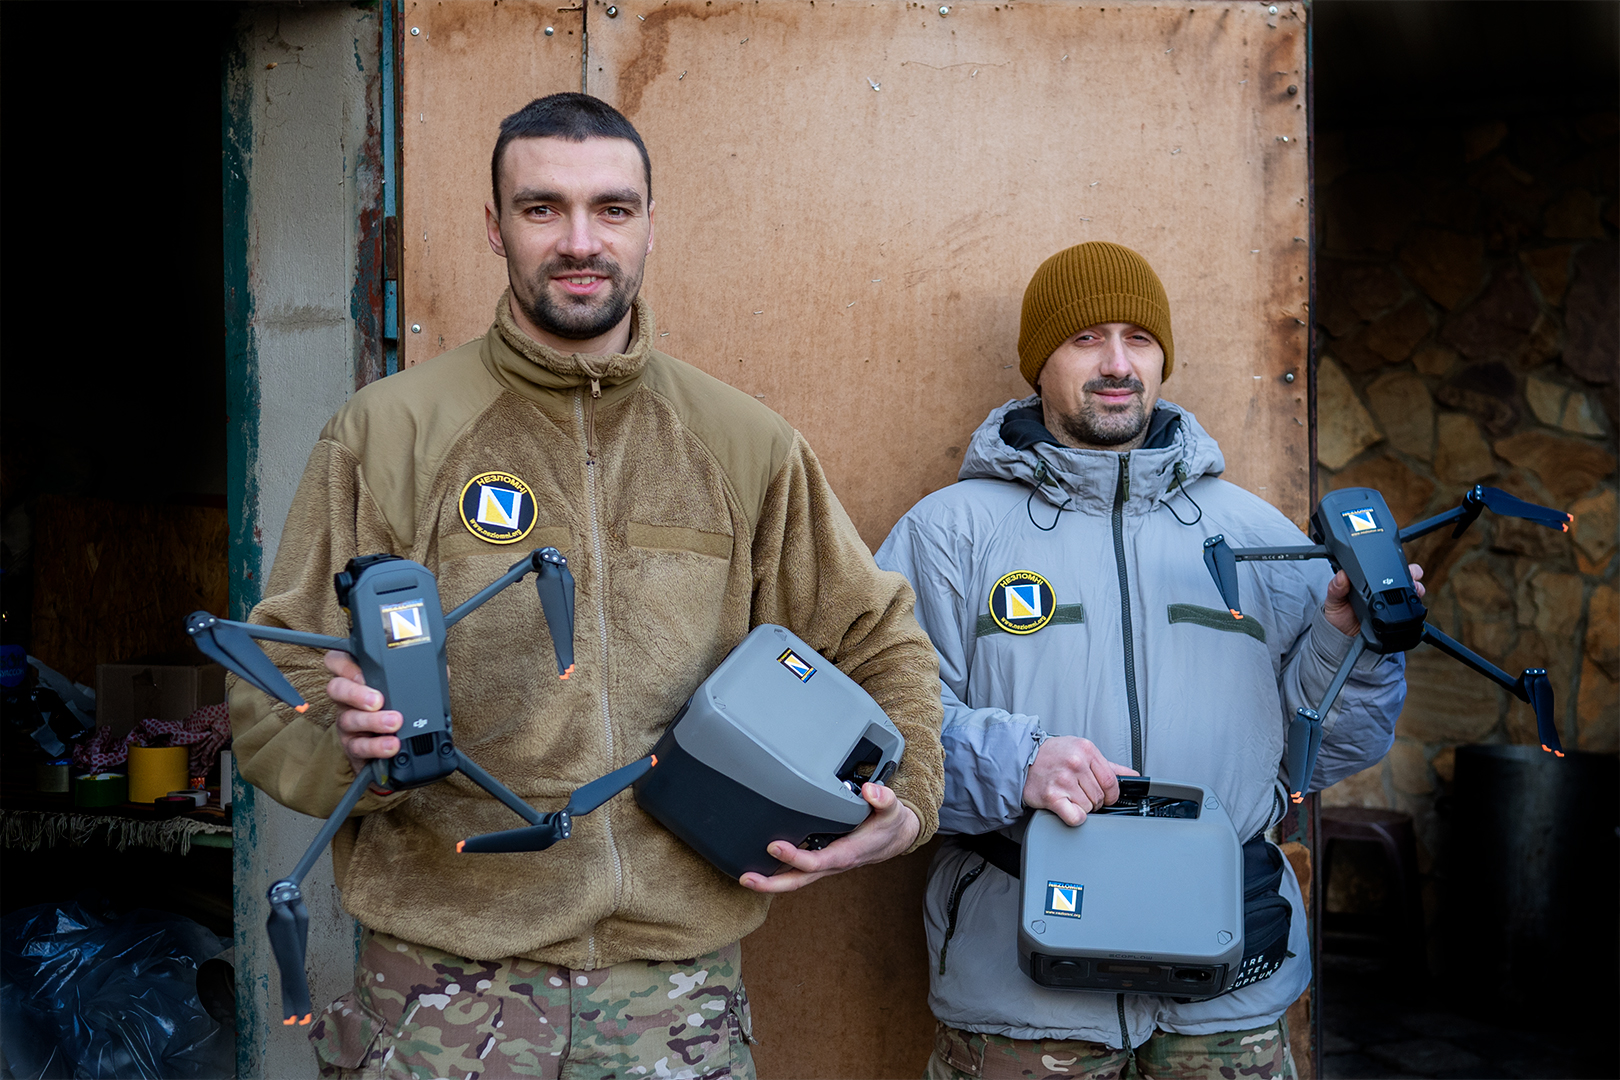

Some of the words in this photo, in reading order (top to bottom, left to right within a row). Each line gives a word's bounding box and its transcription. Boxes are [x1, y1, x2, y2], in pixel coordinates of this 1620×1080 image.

[476, 475, 527, 495] НЕЗЛОМНІ
[1000, 573, 1043, 588] НЕЗЛОМНІ
[1242, 954, 1264, 968] IRE
[1237, 962, 1269, 979] ATER
